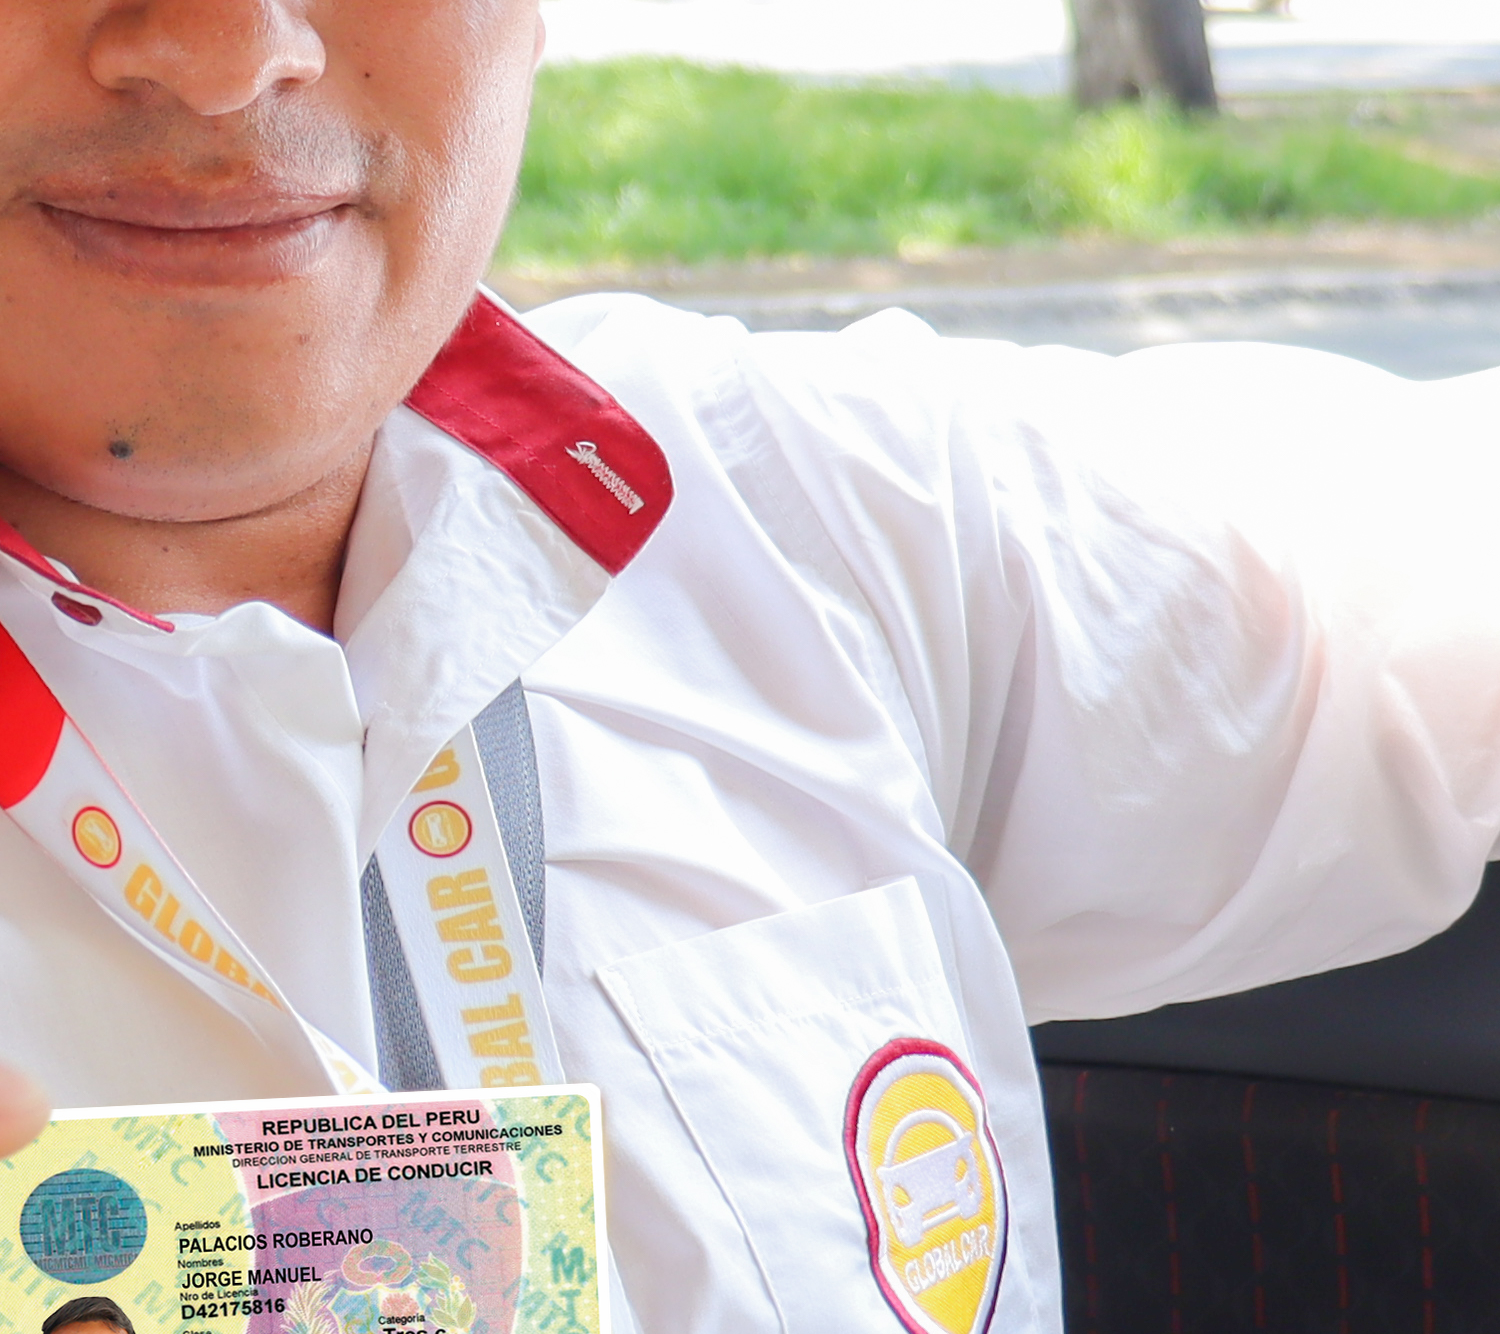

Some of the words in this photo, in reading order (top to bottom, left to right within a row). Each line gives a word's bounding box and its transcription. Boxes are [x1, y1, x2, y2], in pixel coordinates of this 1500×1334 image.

[426, 866, 513, 984] CAR
[262, 1116, 376, 1136] REPUBLICA
[382, 1113, 421, 1129] DEL
[426, 1110, 480, 1126] PERU
[193, 1141, 280, 1158] MINISTERIO
[283, 1140, 303, 1152] DE
[307, 1133, 415, 1151] TRANSPORTES
[418, 1132, 429, 1143] Y
[431, 1124, 563, 1143] COMUNICACIONES
[232, 1155, 297, 1168] DIRECCION
[300, 1151, 354, 1165] GENERAL
[356, 1149, 372, 1160] DE
[375, 1145, 450, 1159] TRANSPORTE
[453, 1141, 521, 1155] TERRESTRE
[257, 1169, 351, 1189] LICENCIA
[355, 1166, 382, 1182] DE
[387, 1160, 493, 1181] CONDUCIR
[40, 1194, 122, 1257] MTC
[174, 1220, 221, 1232] Apellidos
[179, 1234, 267, 1254] PALACIOS
[272, 1228, 374, 1249] ROBERANO
[177, 1258, 224, 1269] Nombres
[904, 1239, 963, 1294] GLOBAL
[960, 1224, 994, 1265] CAR
[181, 1271, 243, 1289] JORGE
[247, 1267, 322, 1285] MANUEL
[179, 1292, 199, 1302] Nro
[201, 1291, 214, 1300] de
[217, 1288, 259, 1299] Licencia
[181, 1298, 285, 1320] D42175816
[378, 1313, 426, 1327] Categoría
